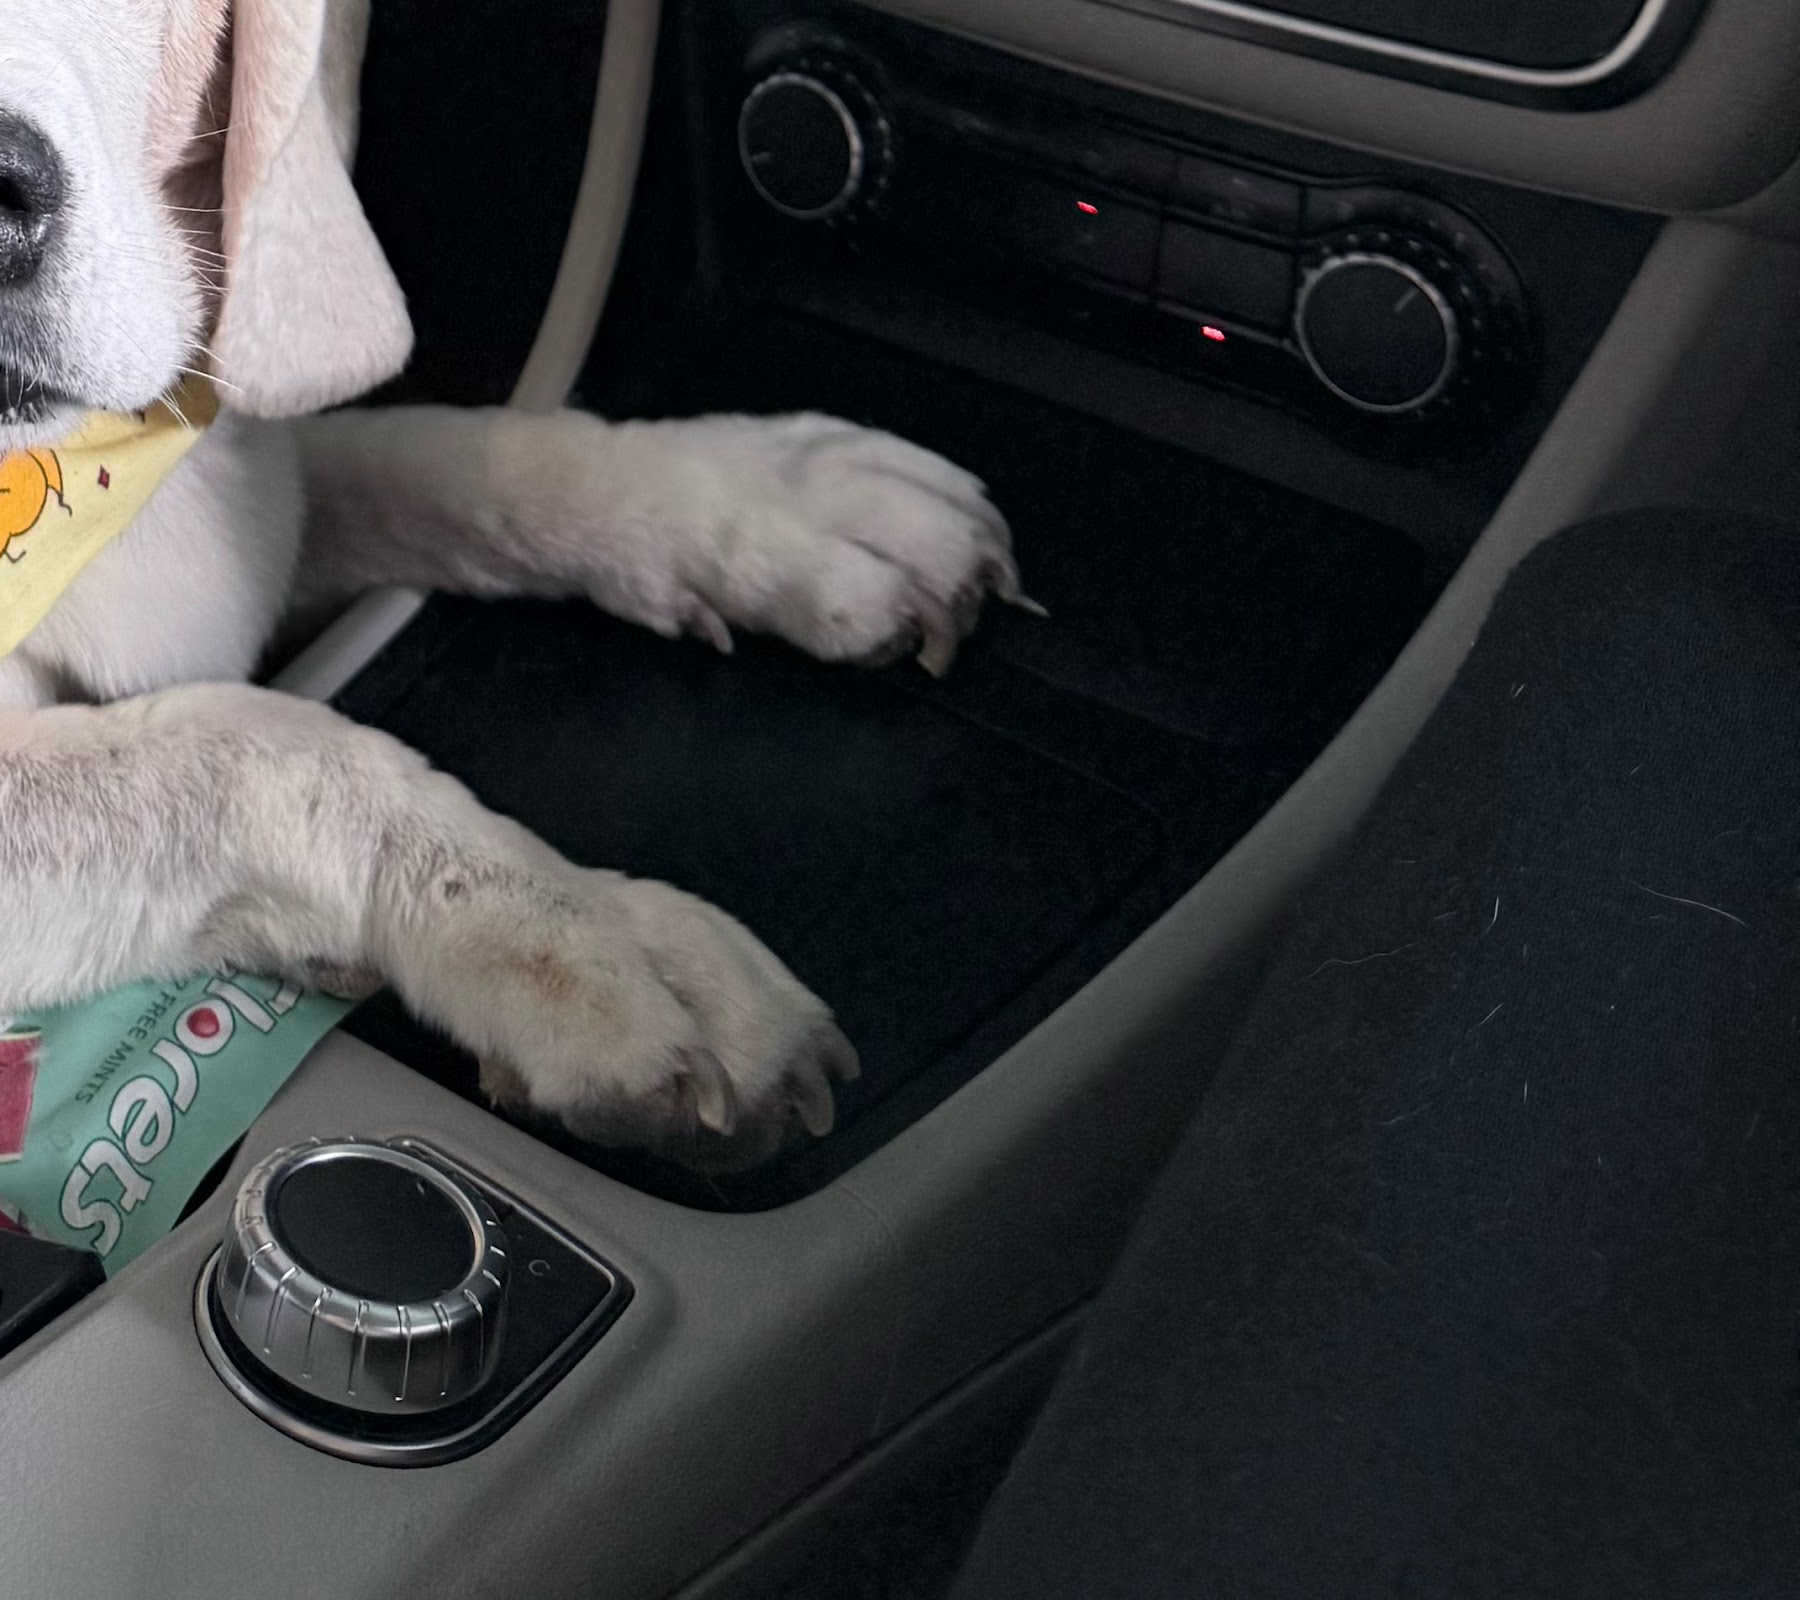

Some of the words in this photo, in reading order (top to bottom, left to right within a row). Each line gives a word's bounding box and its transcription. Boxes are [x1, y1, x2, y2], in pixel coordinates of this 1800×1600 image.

[128, 990, 177, 1041] FREE
[75, 1040, 135, 1104] MINTS
[61, 968, 304, 1258] lorets
